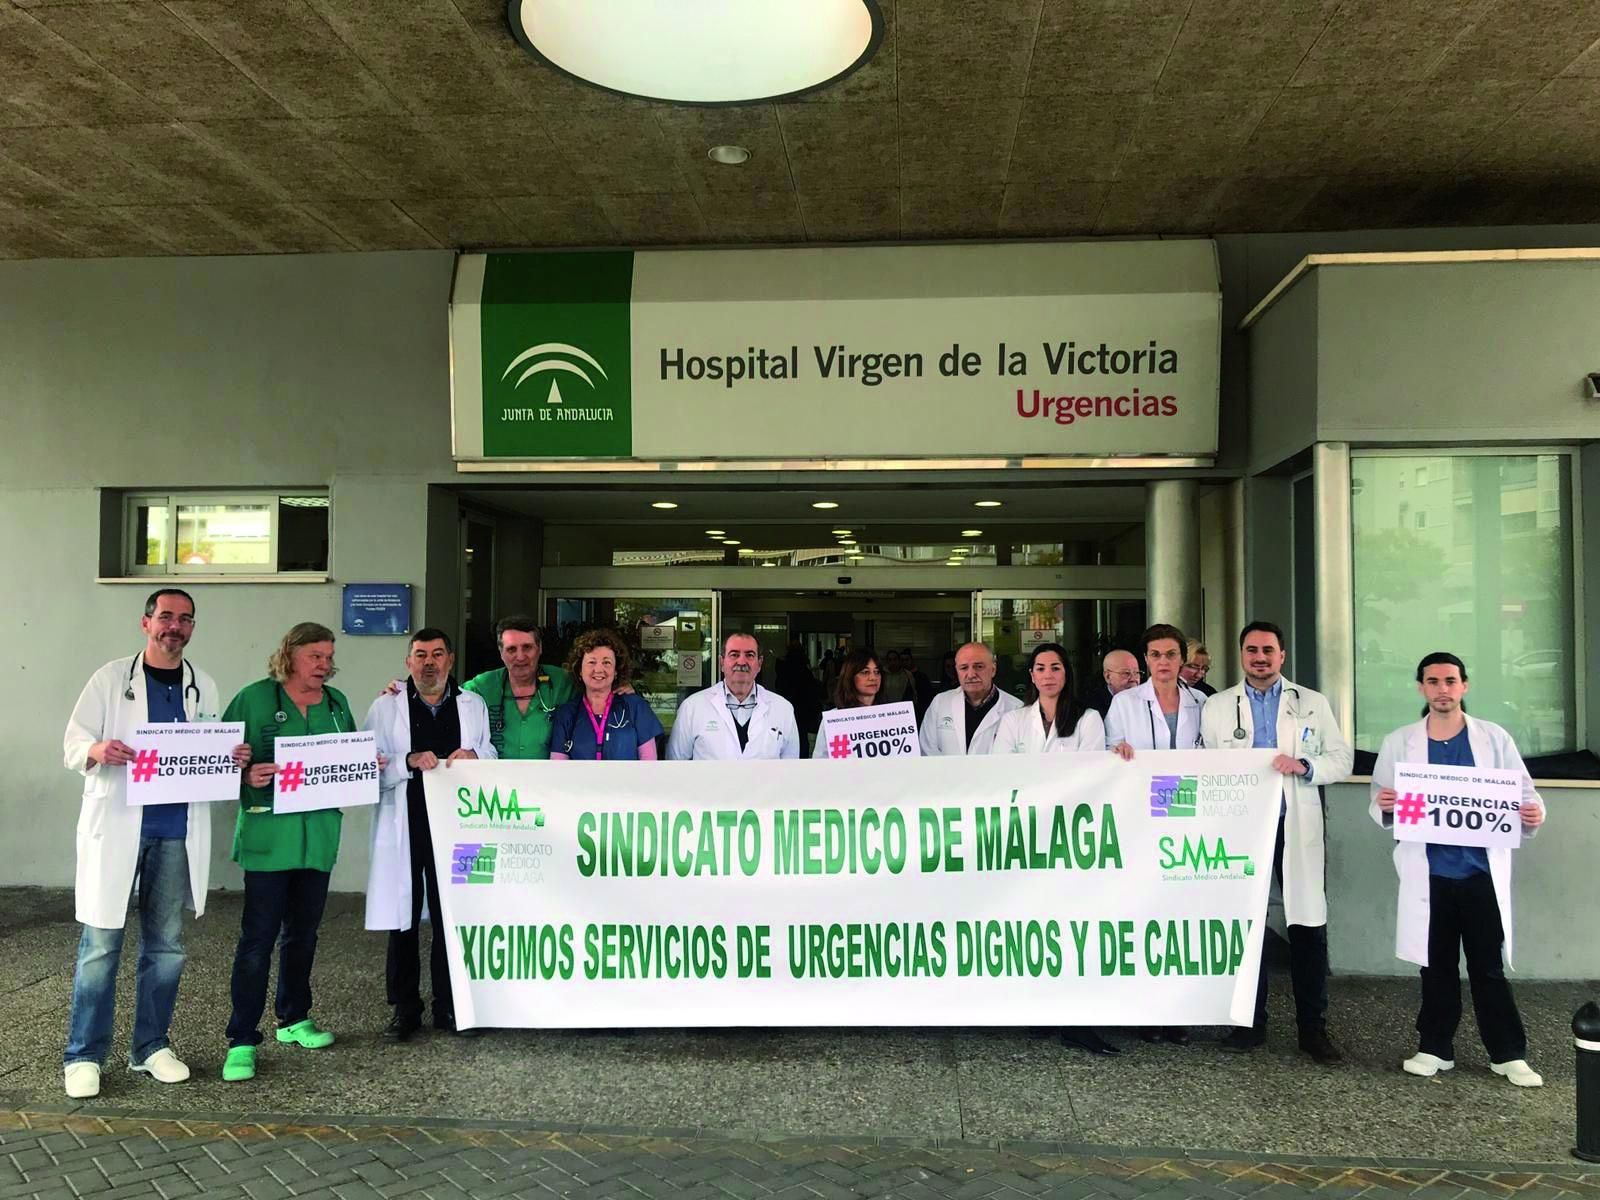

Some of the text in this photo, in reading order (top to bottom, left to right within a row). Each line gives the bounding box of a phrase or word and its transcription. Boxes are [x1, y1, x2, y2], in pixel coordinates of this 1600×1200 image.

[660, 341, 1178, 388] Hospital Virgen de la Victoria
[1016, 388, 1178, 425] Urgencias
[501, 408, 614, 421] JUNTA DE ANDALUCIA
[827, 716, 855, 724] SINDICATO
[852, 737, 912, 759] 100%
[158, 764, 239, 776] LO URGENTE
[1399, 772, 1438, 780] SINDICATO
[304, 771, 377, 786] LO URGENTE
[1201, 774, 1259, 787] SINDICATO
[1428, 807, 1512, 833] 100%
[577, 790, 1123, 878] SINDICATO MEDICO DE MÁLAGA
[501, 842, 553, 856] SINDICATO
[456, 919, 1253, 980] XIGIMOS SERVICIOS DE URGENCIAS DIGNOS Y DE CALIDA
